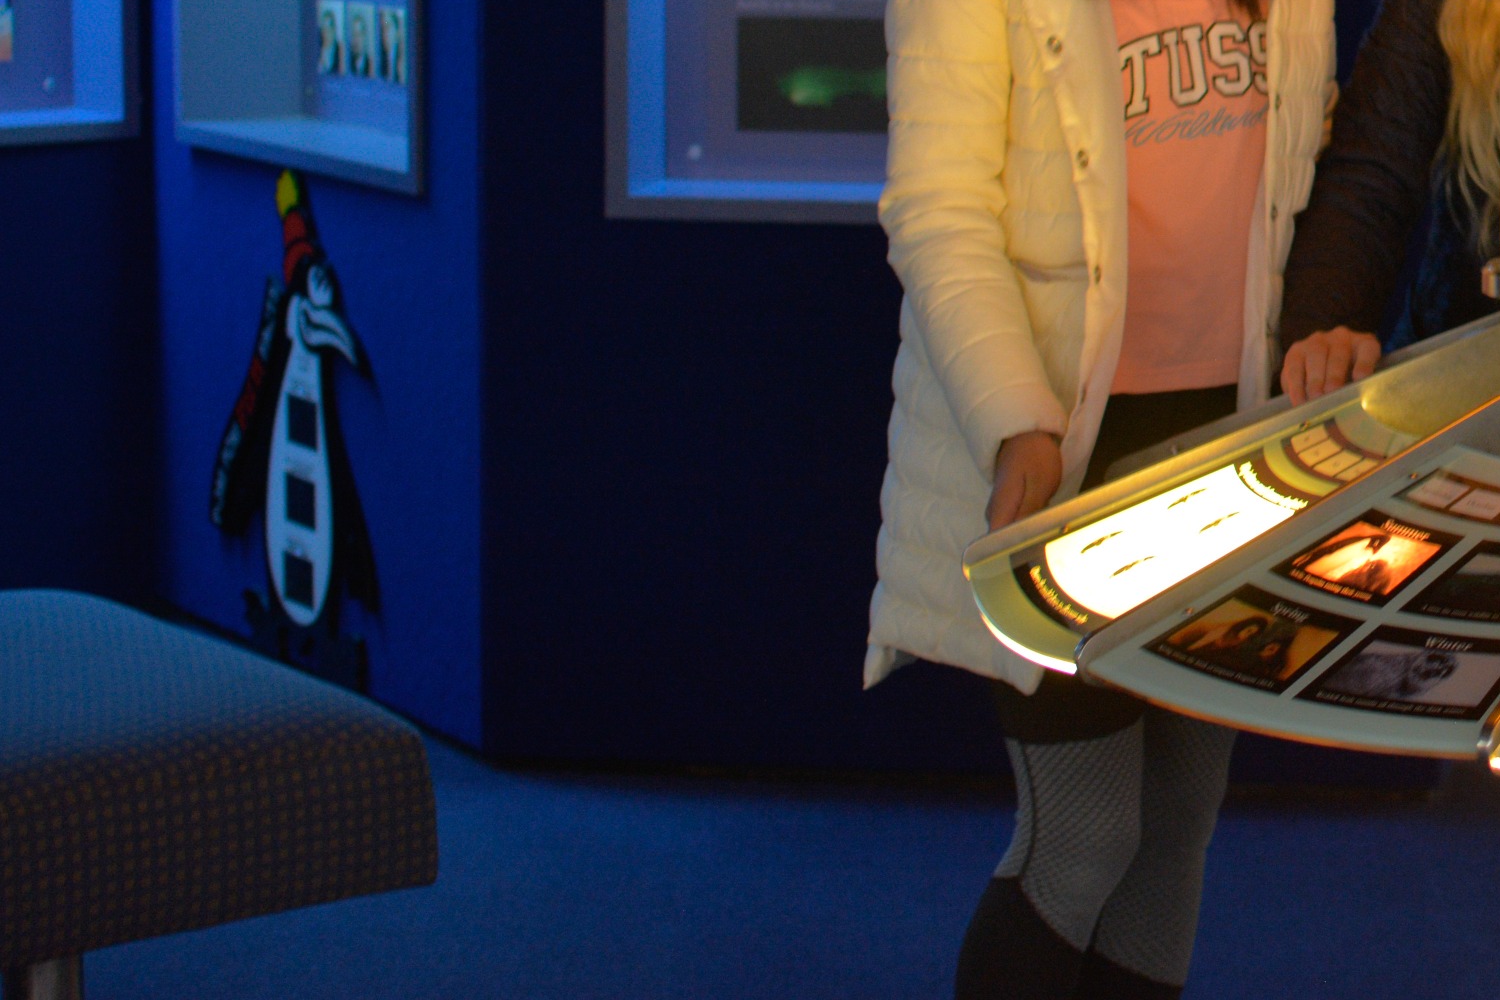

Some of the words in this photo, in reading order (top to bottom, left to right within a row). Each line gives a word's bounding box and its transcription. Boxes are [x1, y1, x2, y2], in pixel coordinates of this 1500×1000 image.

[1380, 518, 1431, 541] Summer
[1270, 601, 1311, 624] Spring
[1425, 635, 1474, 651] Winter
